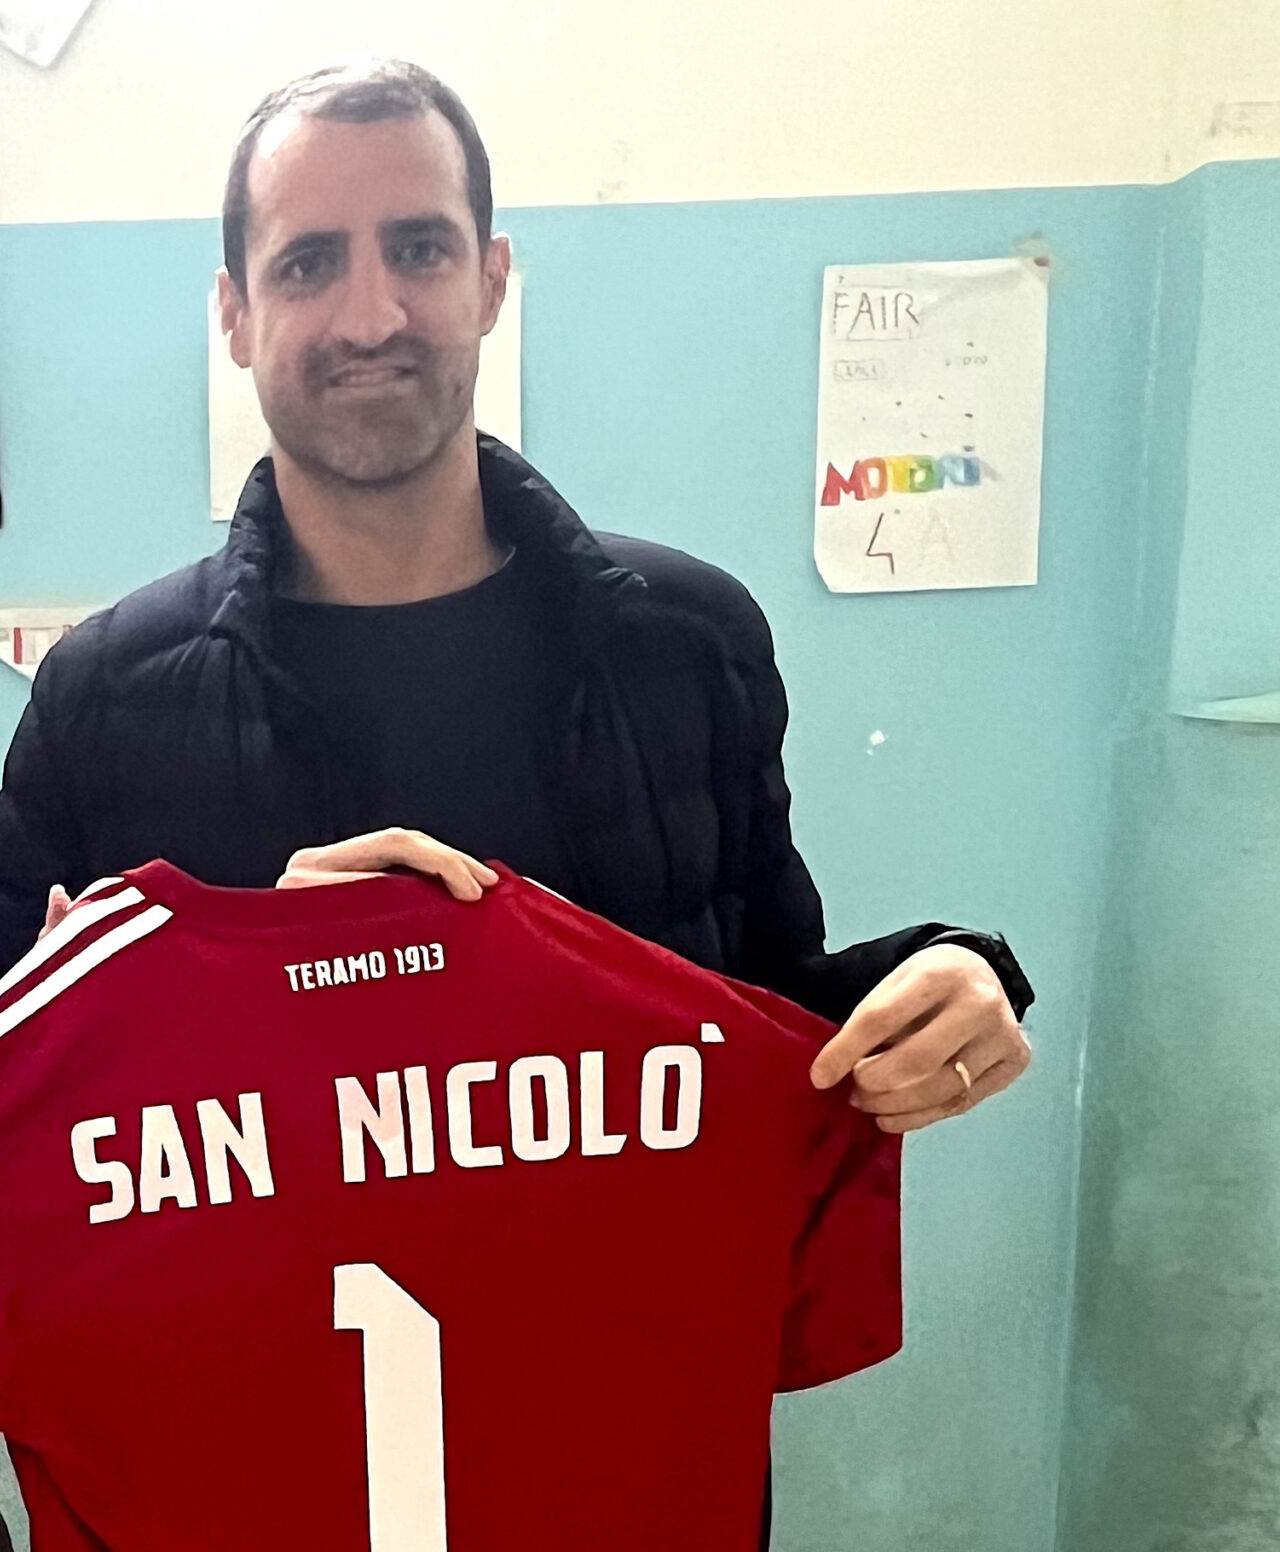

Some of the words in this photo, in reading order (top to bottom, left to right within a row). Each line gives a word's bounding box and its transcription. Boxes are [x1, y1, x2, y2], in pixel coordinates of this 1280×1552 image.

[832, 291, 919, 338] FAIR
[283, 951, 386, 992] TERAMO
[393, 942, 445, 975] 1913
[71, 1091, 275, 1225] SAN
[333, 1262, 448, 1552] 1
